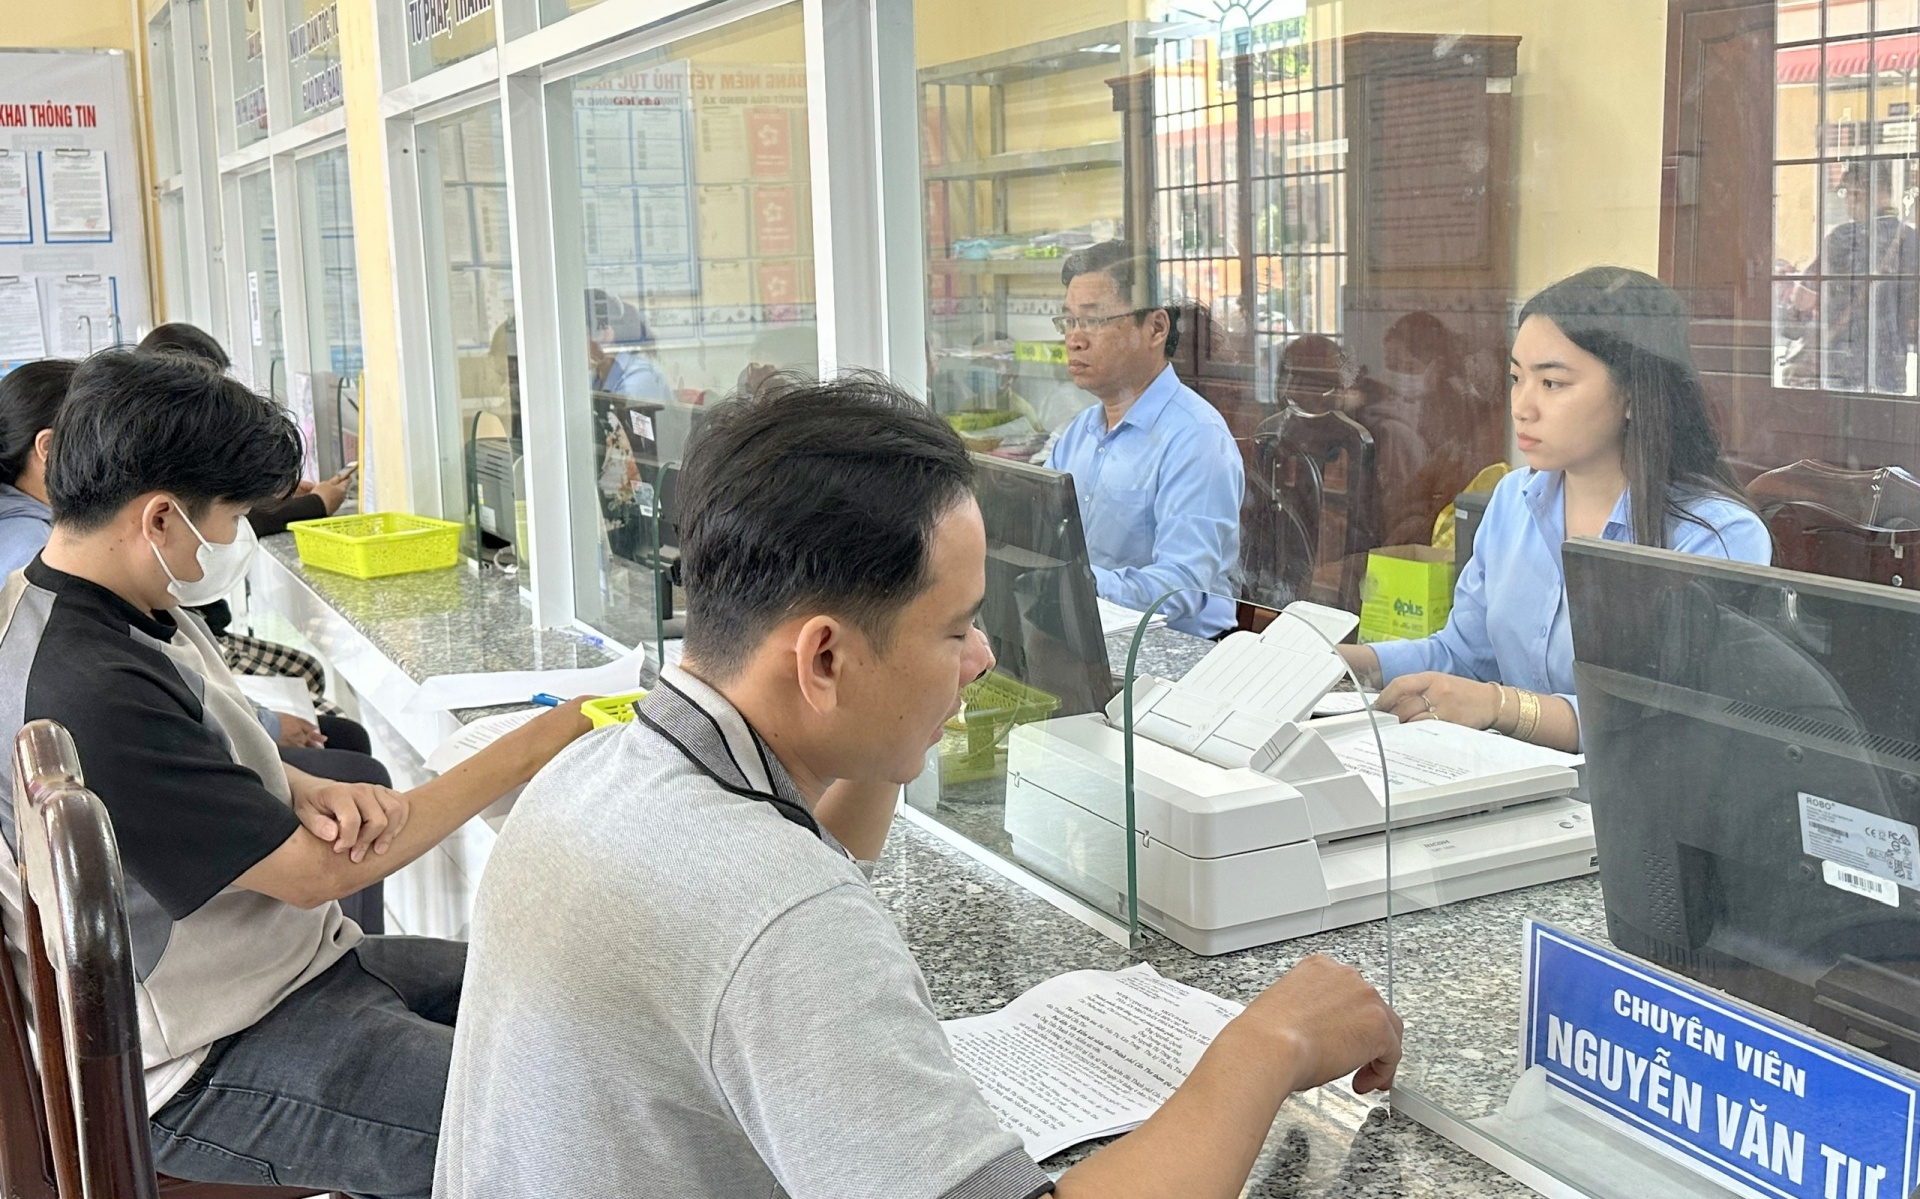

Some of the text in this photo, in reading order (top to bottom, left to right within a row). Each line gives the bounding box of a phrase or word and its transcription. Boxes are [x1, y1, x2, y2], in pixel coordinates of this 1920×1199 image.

[0, 100, 96, 127] KHAI THÔNG TIN
[1614, 988, 1806, 1098] CHUYÊN VIÊN
[1548, 1014, 1702, 1134] NGUYỄN
[1716, 1093, 1806, 1185] VĂN
